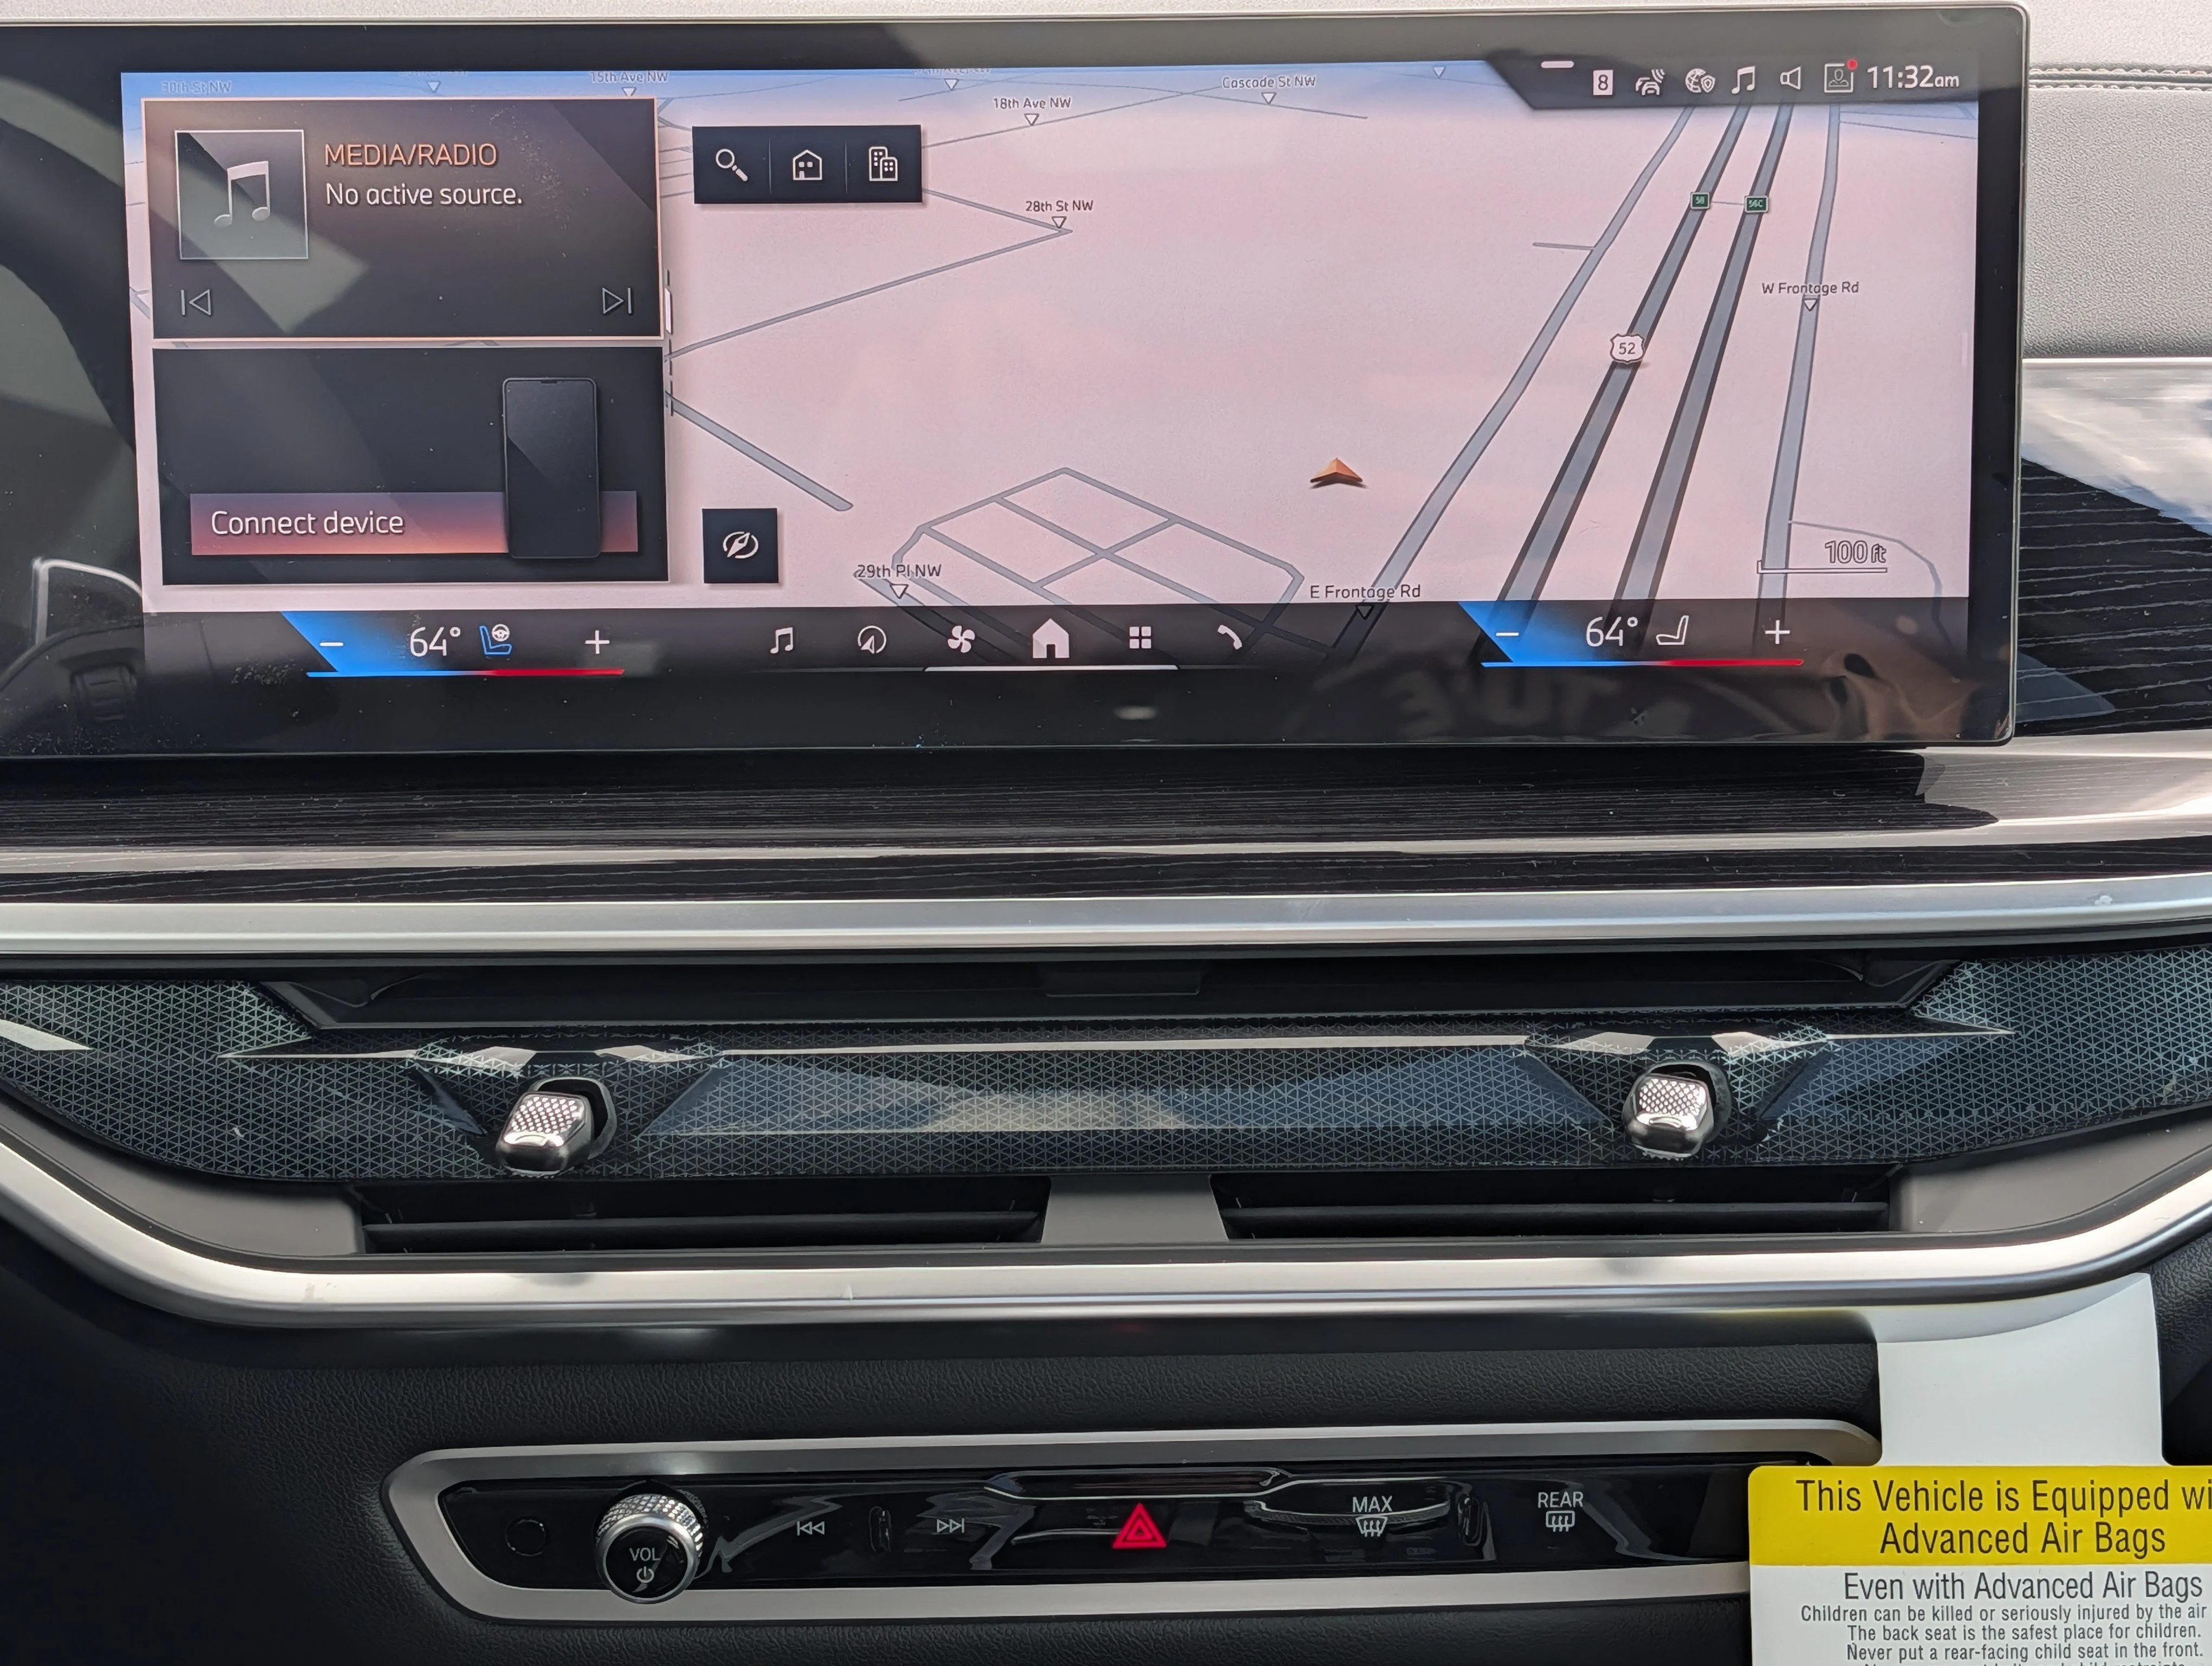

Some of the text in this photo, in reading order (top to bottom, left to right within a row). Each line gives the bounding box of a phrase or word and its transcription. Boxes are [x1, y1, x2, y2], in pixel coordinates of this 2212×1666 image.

[591, 70, 668, 82] 15th Ave NW
[1223, 75, 1316, 88] Cascade St NW
[1598, 74, 1609, 91] 8
[1867, 65, 1959, 88] 11:32am
[192, 81, 206, 93] St
[209, 81, 232, 93] NW
[993, 97, 1071, 108] 18th Ave NW
[325, 143, 497, 165] MEDIA/RADIO
[326, 183, 522, 205] No active source.
[1025, 200, 1094, 212] 28th St NW
[1762, 281, 1859, 296] W Frontage Rd
[1619, 342, 1636, 355] 52
[211, 510, 403, 535] Connect device
[1825, 540, 1887, 564] 100 ft
[858, 564, 891, 578] 29th
[915, 564, 942, 576] NW
[1310, 584, 1420, 601] E Frontage Rd
[1586, 616, 1638, 647] 64°
[410, 626, 461, 657] 64°
[1352, 1496, 1393, 1513] MAX
[1538, 1492, 1584, 1508] REAR
[1796, 1480, 1861, 1511] This
[1873, 1480, 1983, 1511] Vehicle
[1996, 1480, 2020, 1511] is
[2033, 1479, 2169, 1518] Equipped
[1880, 1522, 2165, 1560] Advanced Air Bags
[629, 1547, 661, 1561] VOL
[1844, 1571, 2203, 1603] Even with Advanced Air Bags
[1801, 1604, 2207, 1623] Children can be killed or seriously injured by the air
[1847, 1623, 2201, 1643] The back seat is the safest place for children.
[1847, 1642, 2203, 1663] Never put a rear-facing child seat in the front.
